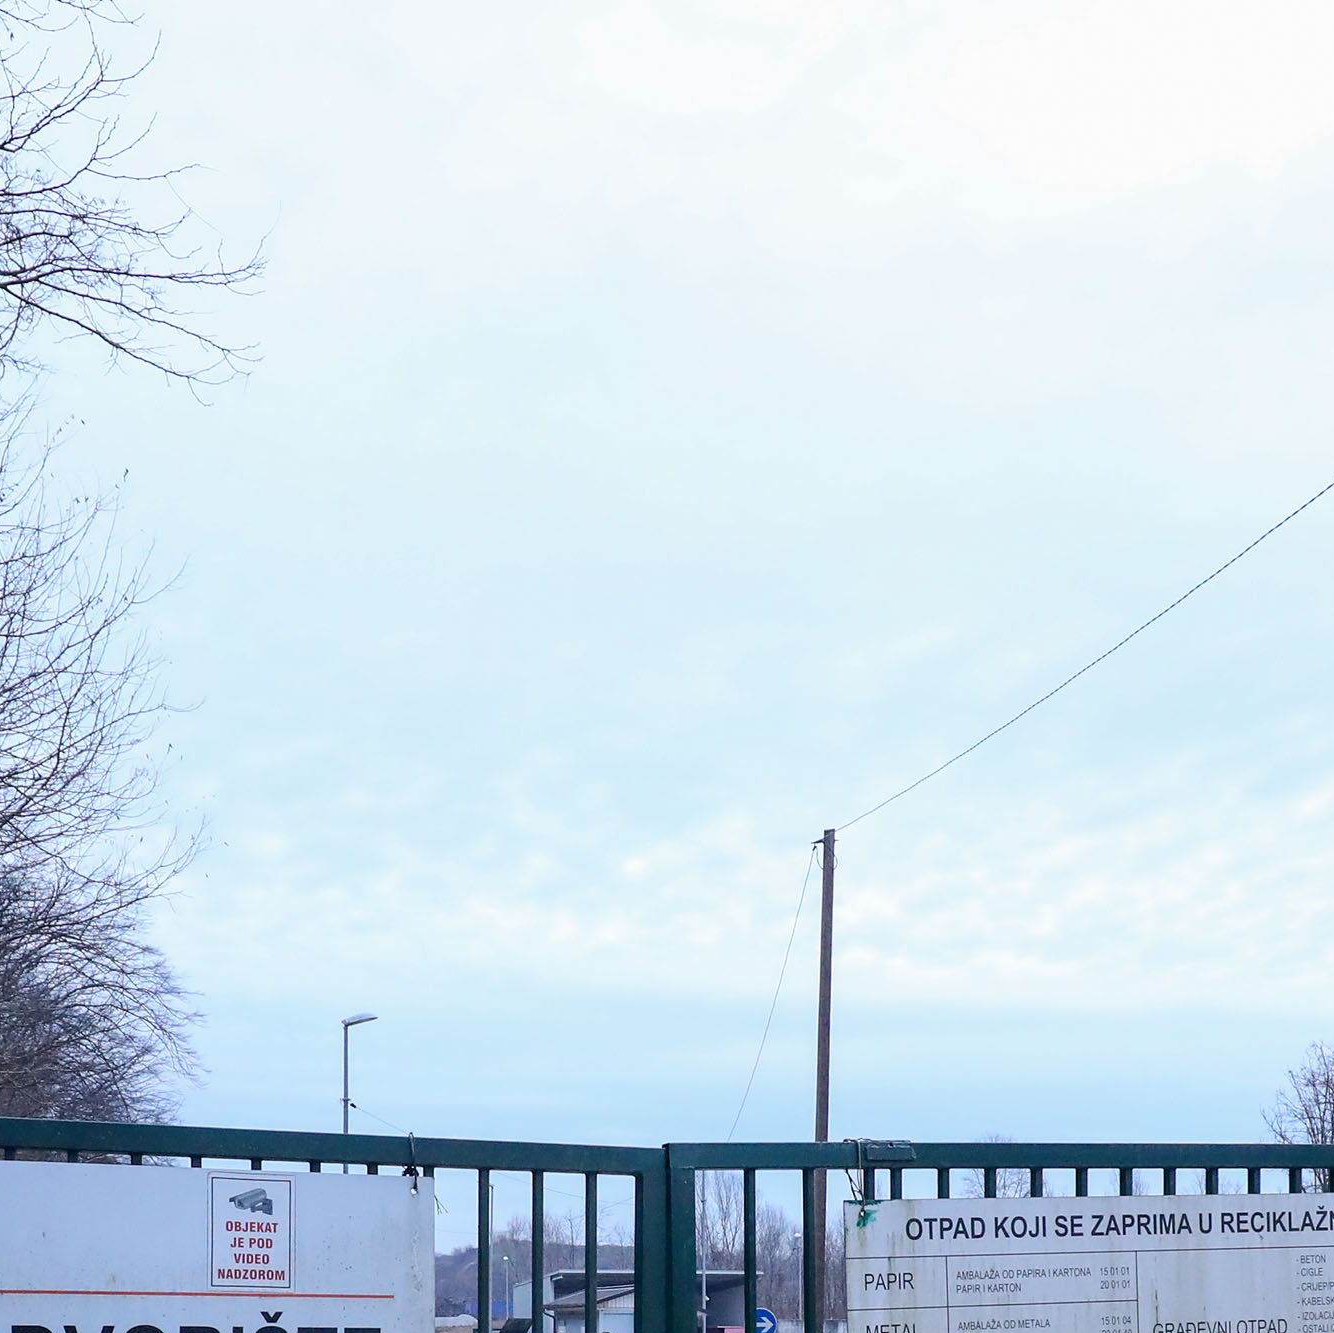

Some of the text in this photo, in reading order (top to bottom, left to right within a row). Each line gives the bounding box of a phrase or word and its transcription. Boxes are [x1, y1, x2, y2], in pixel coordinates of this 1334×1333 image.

[226, 1221, 278, 1233] OBJEKAT
[906, 1217, 985, 1240] OTPAD
[995, 1216, 1046, 1238] KOJI
[1055, 1216, 1083, 1237] SE
[1091, 1214, 1192, 1236] ZAPRIMA
[1199, 1213, 1212, 1234] U
[230, 1237, 272, 1248] JE POD
[234, 1253, 269, 1264] VIDEO
[218, 1269, 285, 1280] NADZOROM
[955, 1268, 1001, 1281] AMBALAŽA
[1001, 1269, 1015, 1280] OD
[1016, 1268, 1047, 1279] PAPIRA
[1052, 1267, 1092, 1278] KARTONA
[1099, 1265, 1130, 1277] 15 01 01
[865, 1273, 914, 1290] PAPIR
[1099, 1279, 1131, 1290] 20 01 01
[955, 1283, 981, 1294] PAPIR
[987, 1282, 1022, 1293] KARTON
[957, 1318, 1051, 1332] AMBALAŽA OD METALA
[1101, 1315, 1132, 1326] 15 01 04
